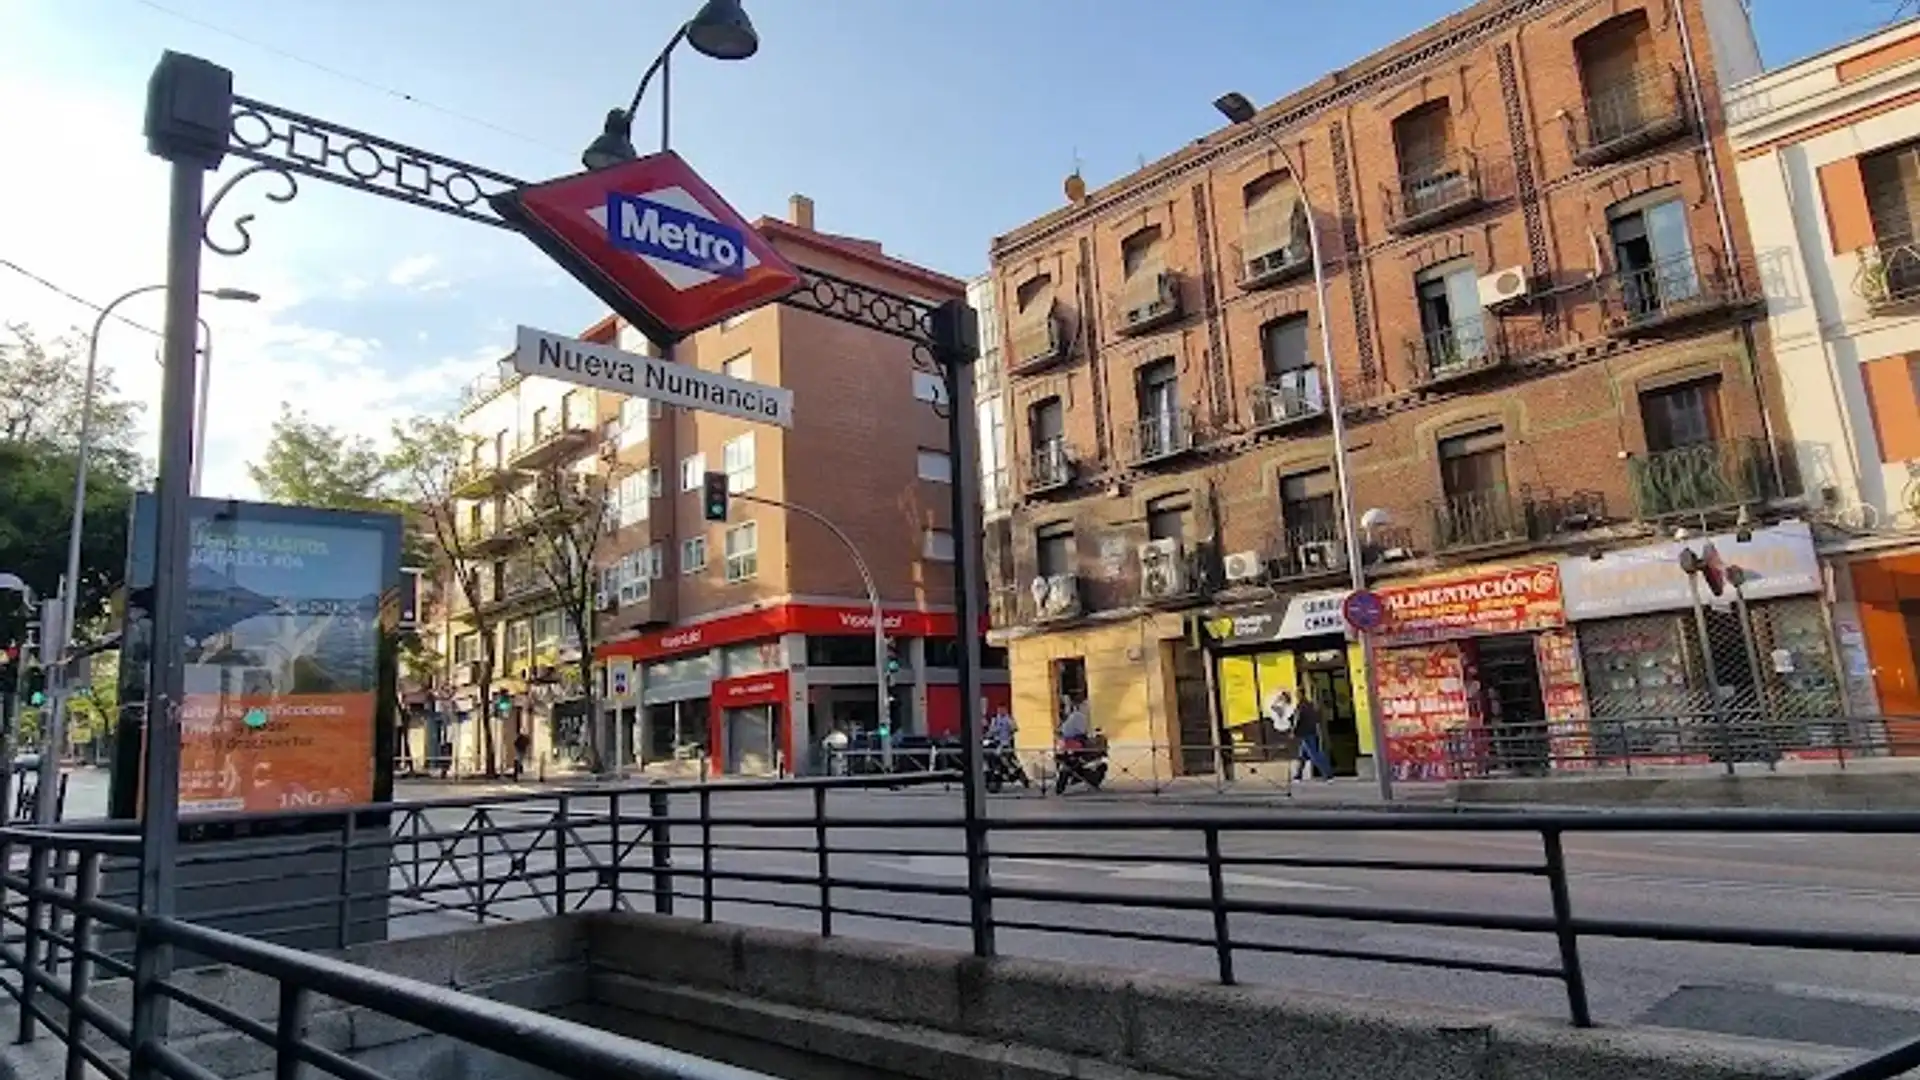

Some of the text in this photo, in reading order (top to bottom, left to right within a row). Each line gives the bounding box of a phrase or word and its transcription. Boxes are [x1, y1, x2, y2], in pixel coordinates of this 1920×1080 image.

[620, 203, 738, 268] Metro
[538, 337, 779, 417] Nueva Numancia
[1387, 573, 1532, 611] ALIMENTACIÓN
[279, 790, 324, 809] ING
